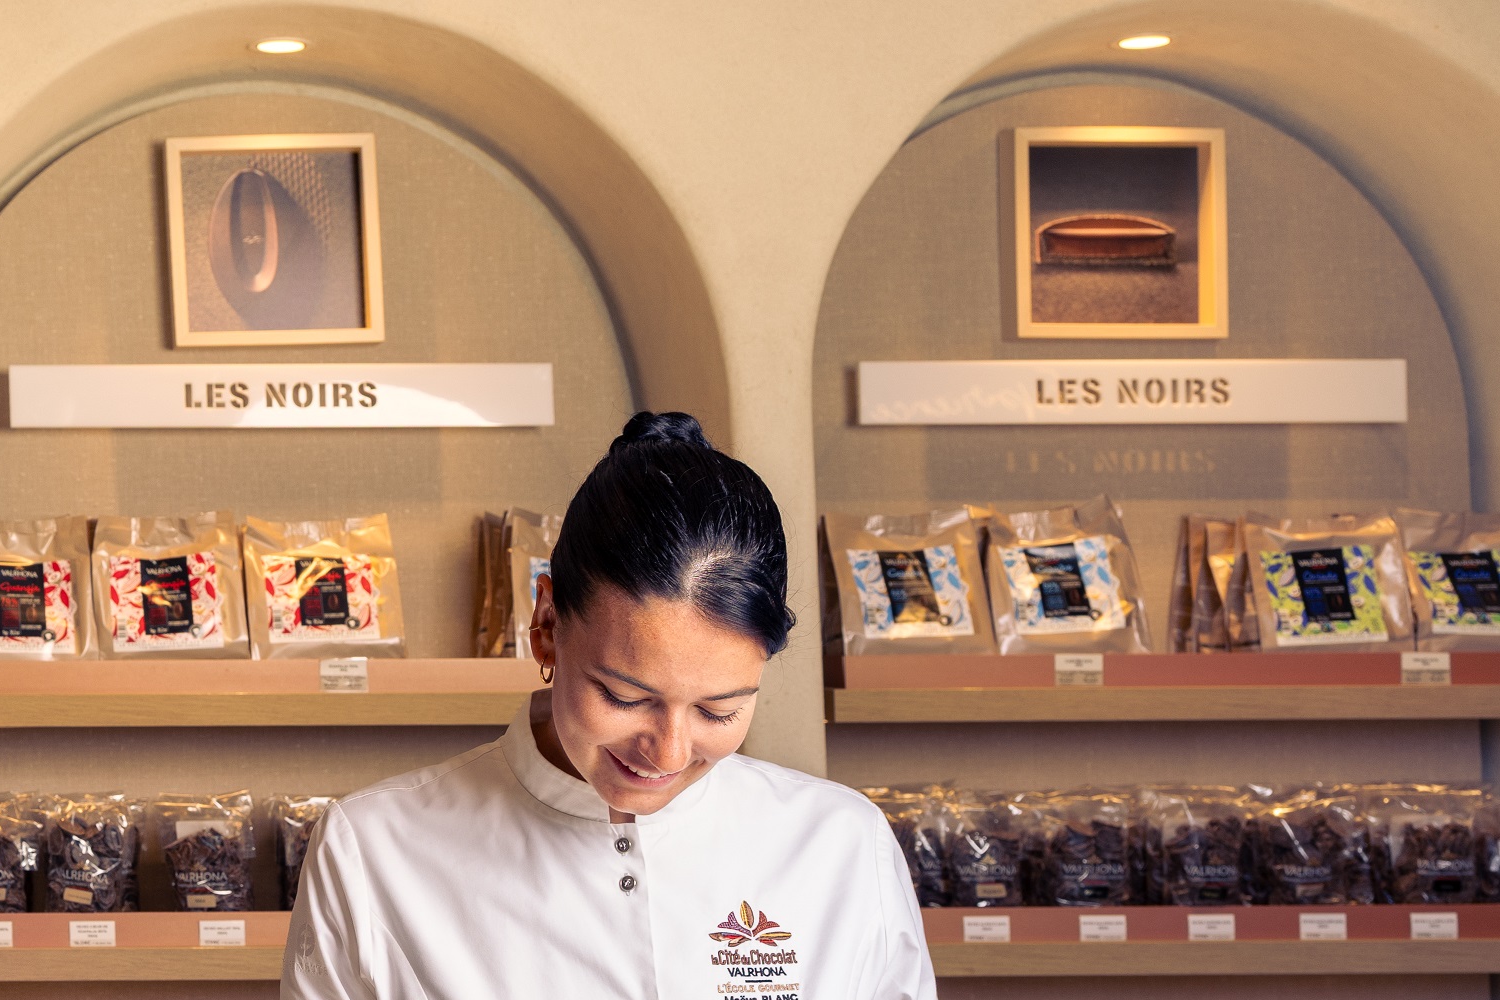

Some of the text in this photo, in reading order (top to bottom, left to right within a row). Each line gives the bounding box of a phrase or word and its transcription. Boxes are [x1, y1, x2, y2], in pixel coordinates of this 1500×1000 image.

[185, 382, 377, 408] LES NOIRS
[1037, 378, 1231, 405] LES NOIRS
[718, 949, 741, 965] Cité
[750, 949, 798, 965] Chocolat
[727, 966, 787, 977] VALRHONA
[758, 982, 800, 993] GOURMET
